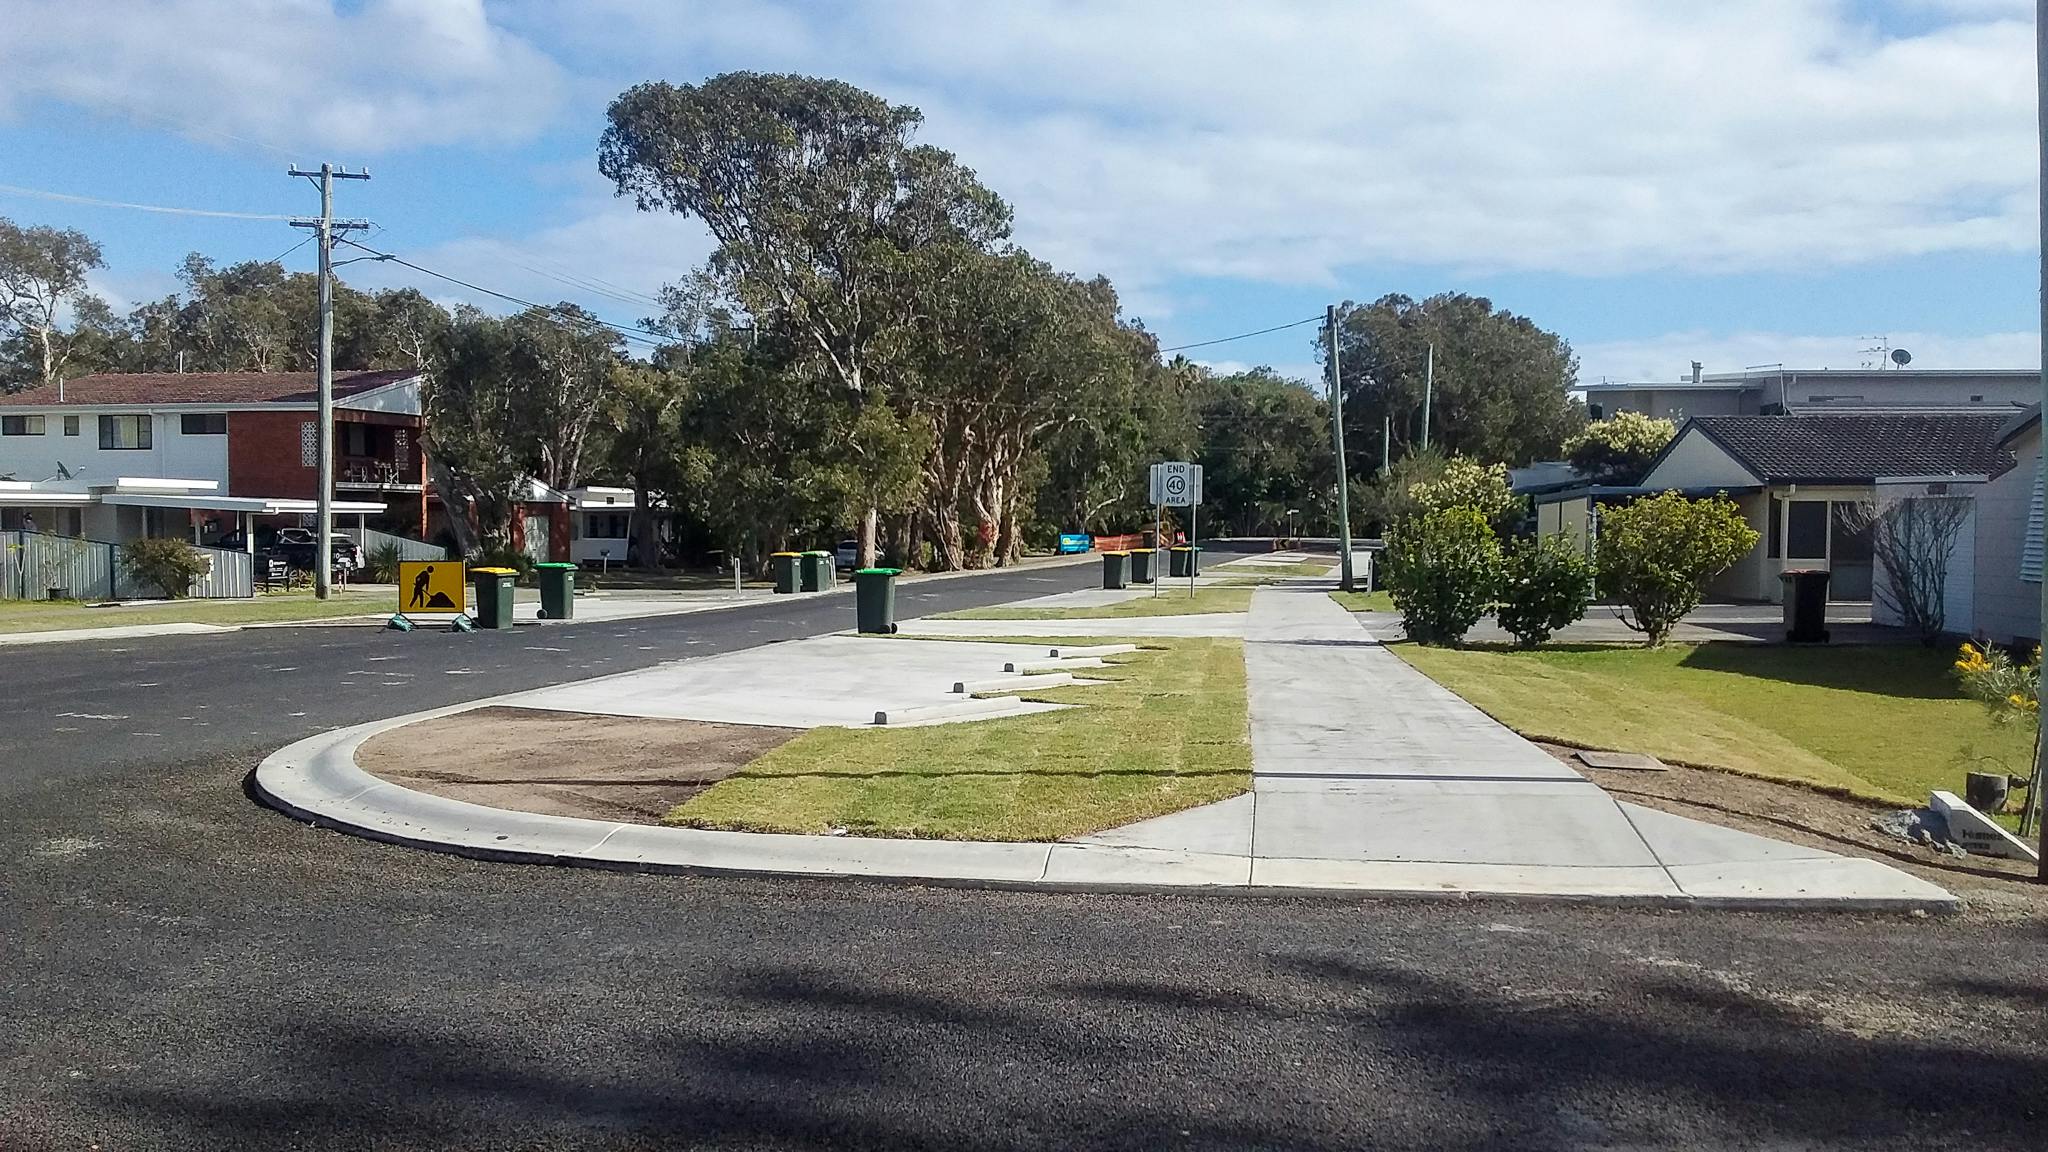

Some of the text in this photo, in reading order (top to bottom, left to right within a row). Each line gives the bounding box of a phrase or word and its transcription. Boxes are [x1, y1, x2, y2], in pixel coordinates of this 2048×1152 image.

[1167, 465, 1185, 473] END
[1168, 480, 1184, 490] 40
[1165, 496, 1185, 504] AREA
